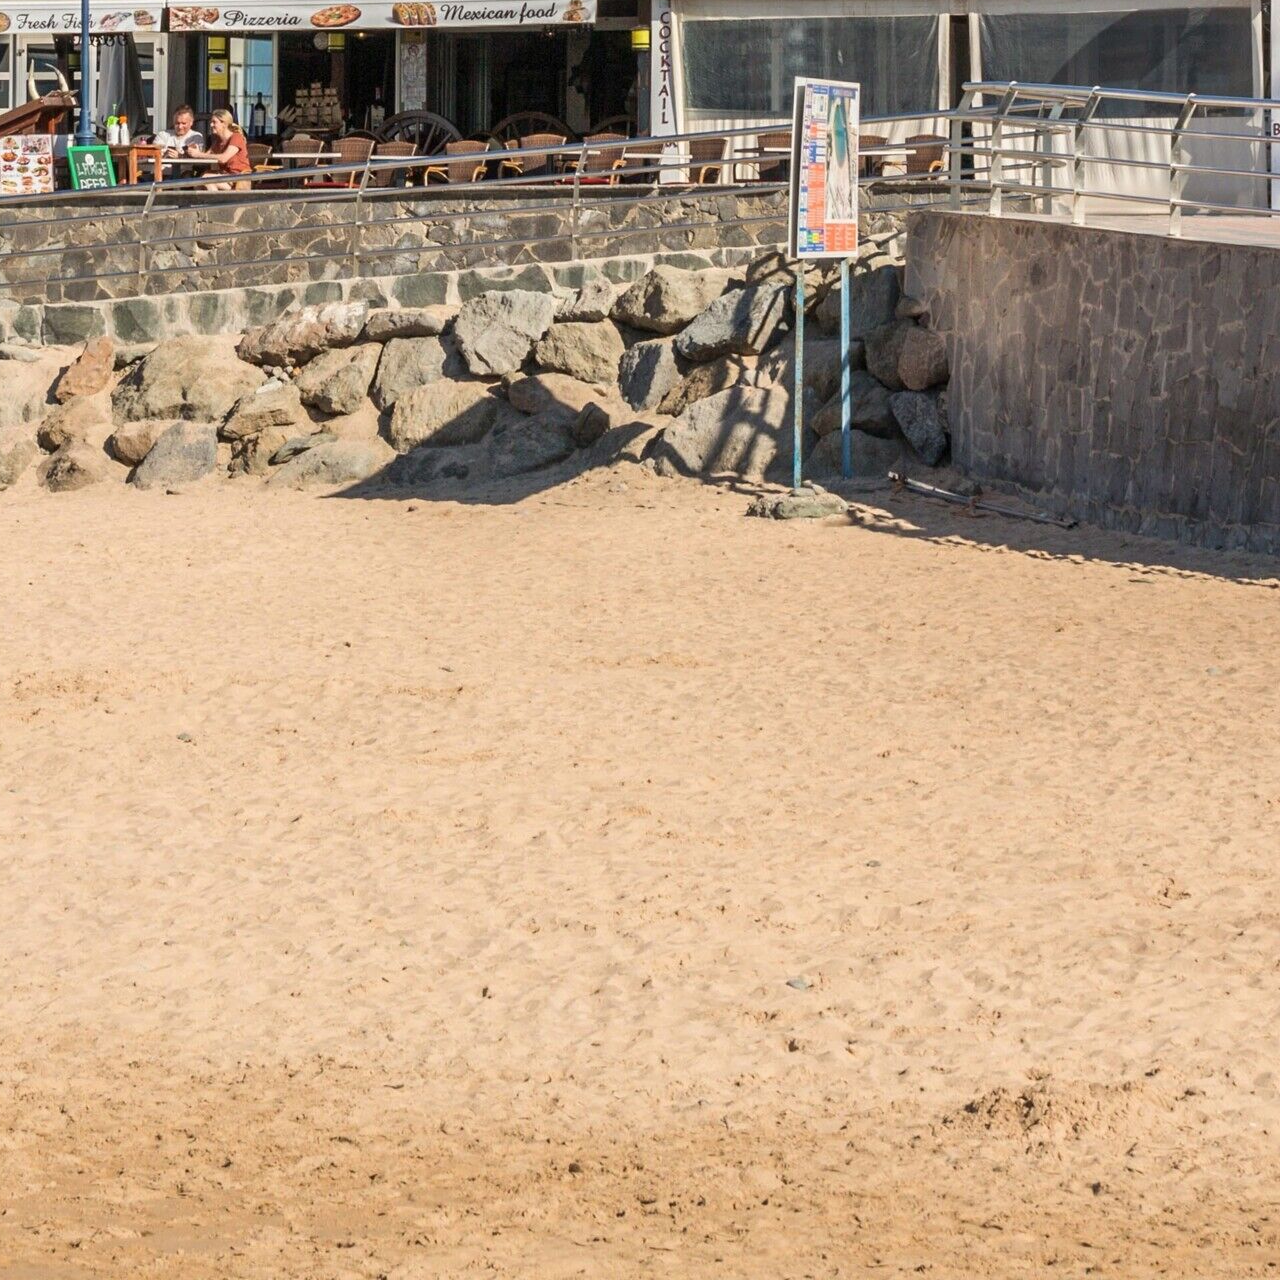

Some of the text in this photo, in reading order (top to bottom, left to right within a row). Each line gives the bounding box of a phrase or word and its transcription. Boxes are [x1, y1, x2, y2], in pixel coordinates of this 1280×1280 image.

[16, 13, 59, 30] Fresh
[223, 9, 302, 27] Pizzeria
[440, 2, 559, 24] Mexican food
[658, 11, 671, 125] COCKTAIL
